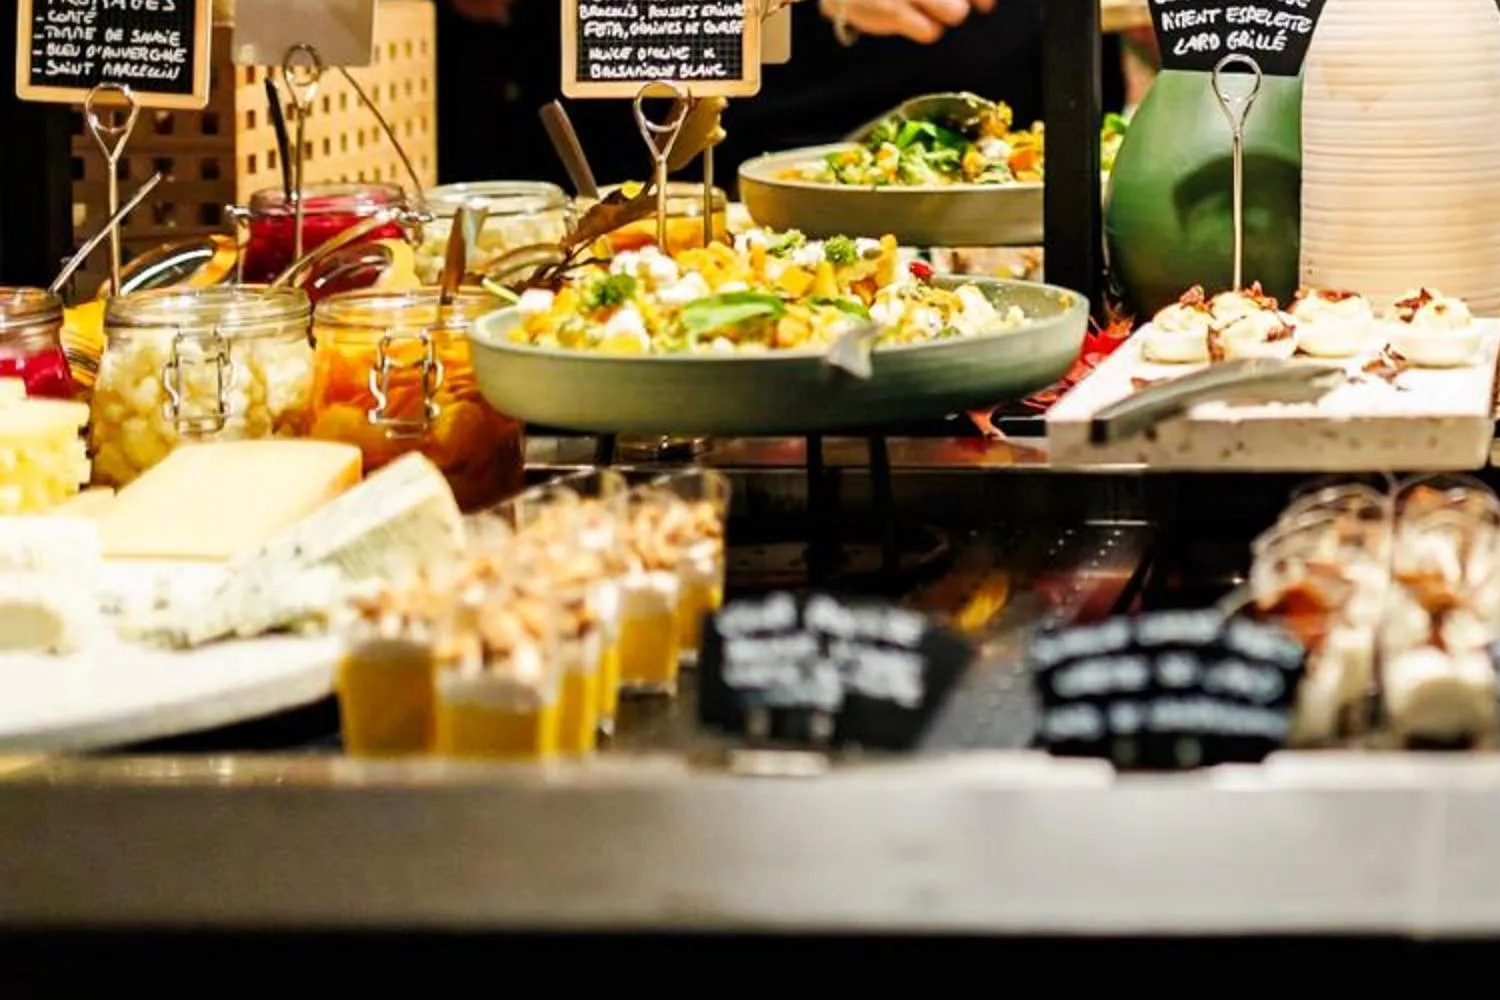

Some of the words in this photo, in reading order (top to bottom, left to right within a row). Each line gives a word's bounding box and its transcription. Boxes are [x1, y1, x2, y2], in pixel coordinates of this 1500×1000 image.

[1225, 5, 1313, 33] ESPELETTE
[104, 28, 124, 43] DE
[1173, 32, 1221, 55] LARD
[1226, 29, 1288, 52] GRILLÉ
[45, 60, 95, 76] SAINT
